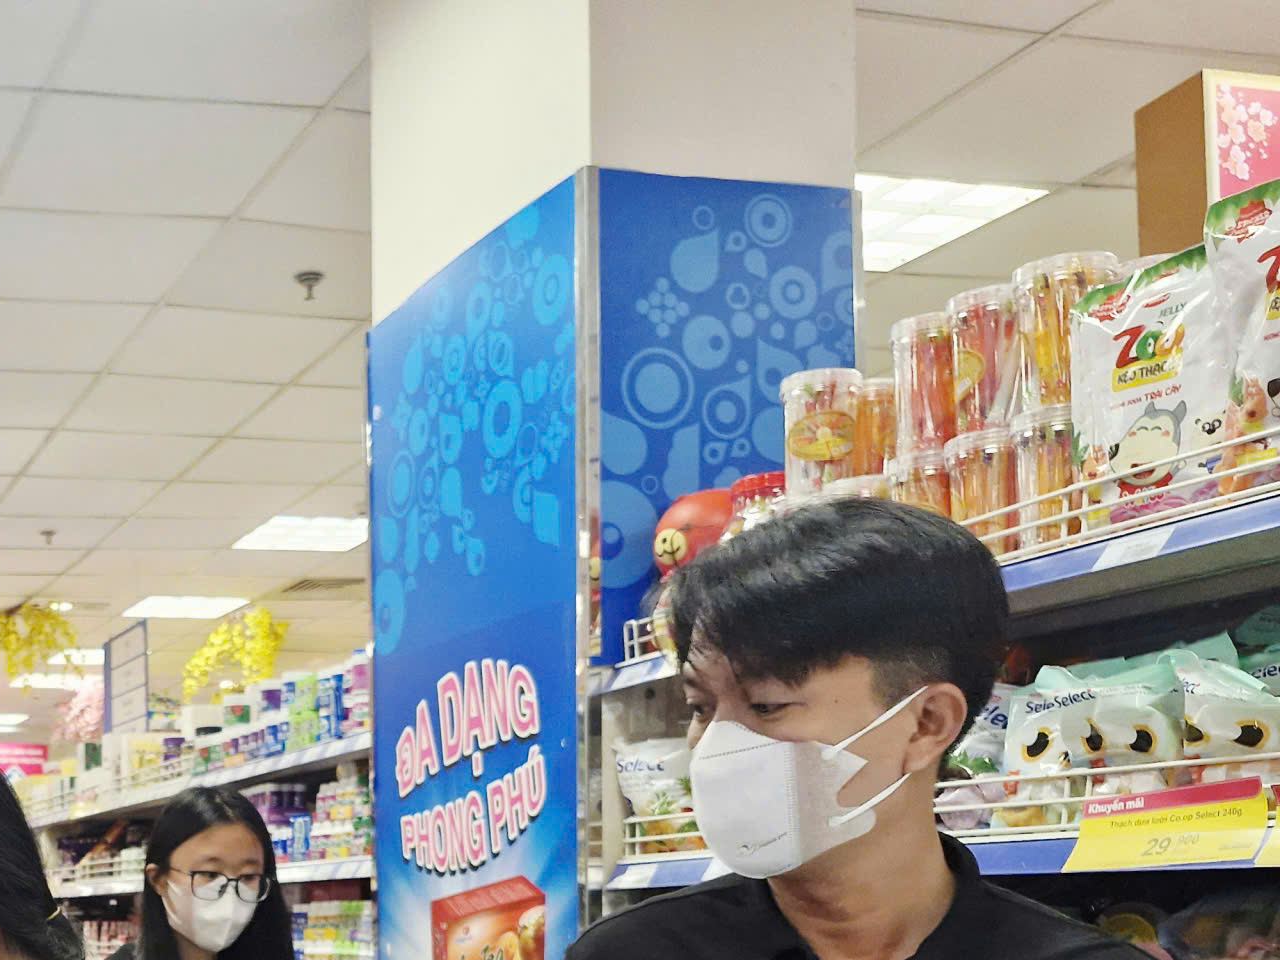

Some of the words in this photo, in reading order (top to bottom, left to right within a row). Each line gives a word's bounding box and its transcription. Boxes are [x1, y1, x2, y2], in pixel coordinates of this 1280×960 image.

[1053, 690, 1097, 709] Select
[395, 698, 440, 799] ĐA
[437, 658, 541, 778] DẠNG
[400, 790, 488, 874] PHONG
[486, 744, 547, 855] PHÚ
[1088, 799, 1124, 815] Khuyến
[1195, 810, 1221, 820] Select
